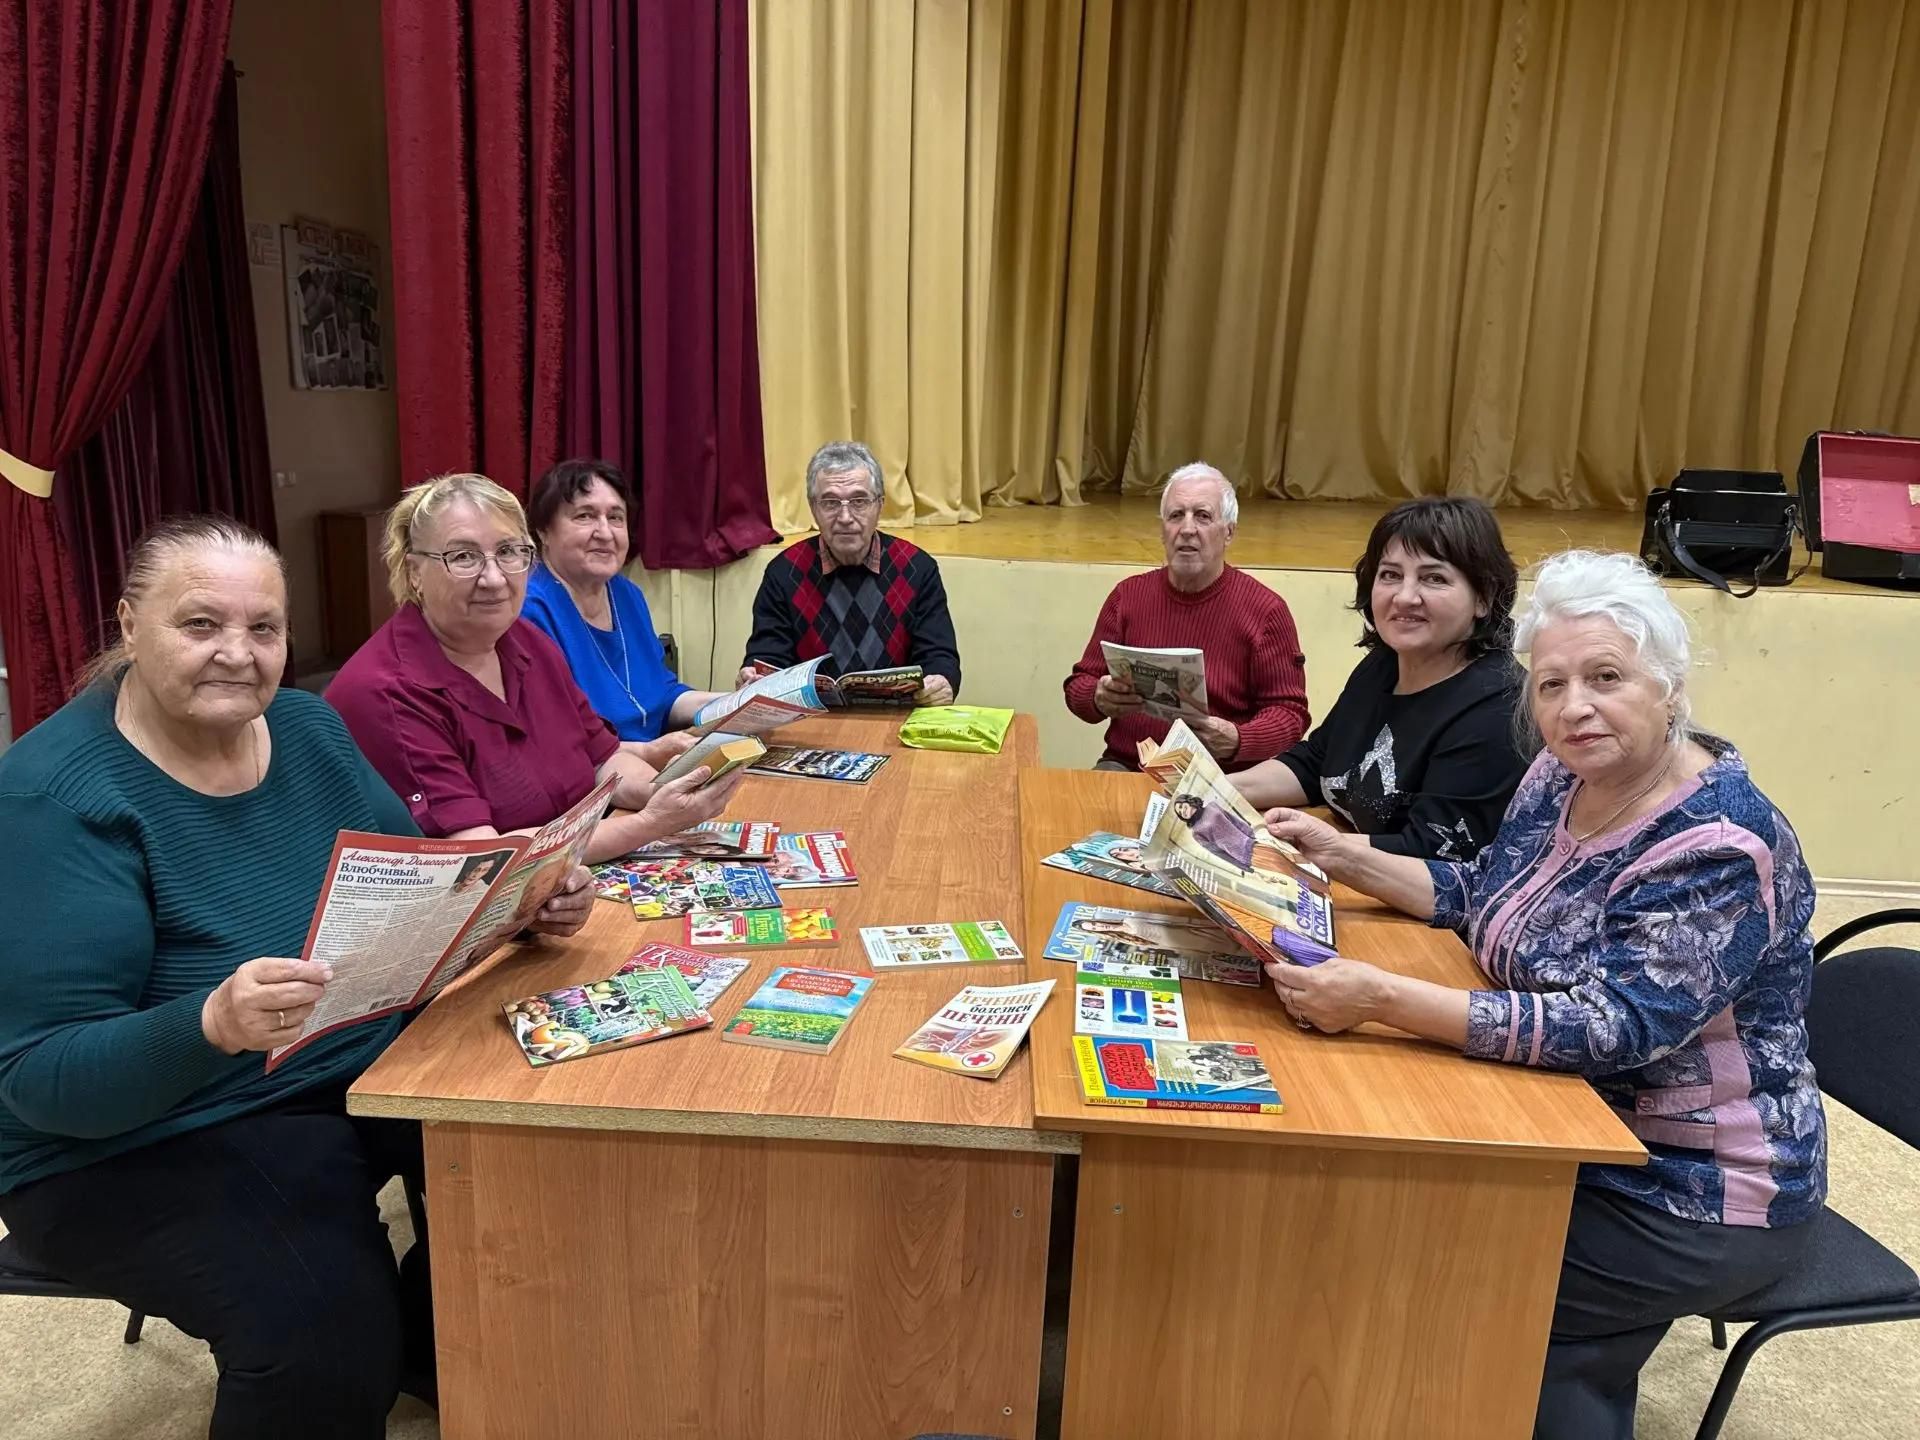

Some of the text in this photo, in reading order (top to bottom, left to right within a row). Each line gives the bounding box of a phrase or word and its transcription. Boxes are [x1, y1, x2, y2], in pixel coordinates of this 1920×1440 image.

[342, 850, 464, 872] Александр Домогаров
[339, 862, 421, 878] Влюбчивый,
[337, 873, 434, 886] но постоянный
[1312, 902, 1329, 938] СОК!
[1049, 905, 1097, 958] Сабрна
[959, 991, 1041, 1006] ЛЕЧЕНИЕ
[969, 1003, 1033, 1014] болезней
[940, 1009, 1027, 1025] ПЕЧЕНИ
